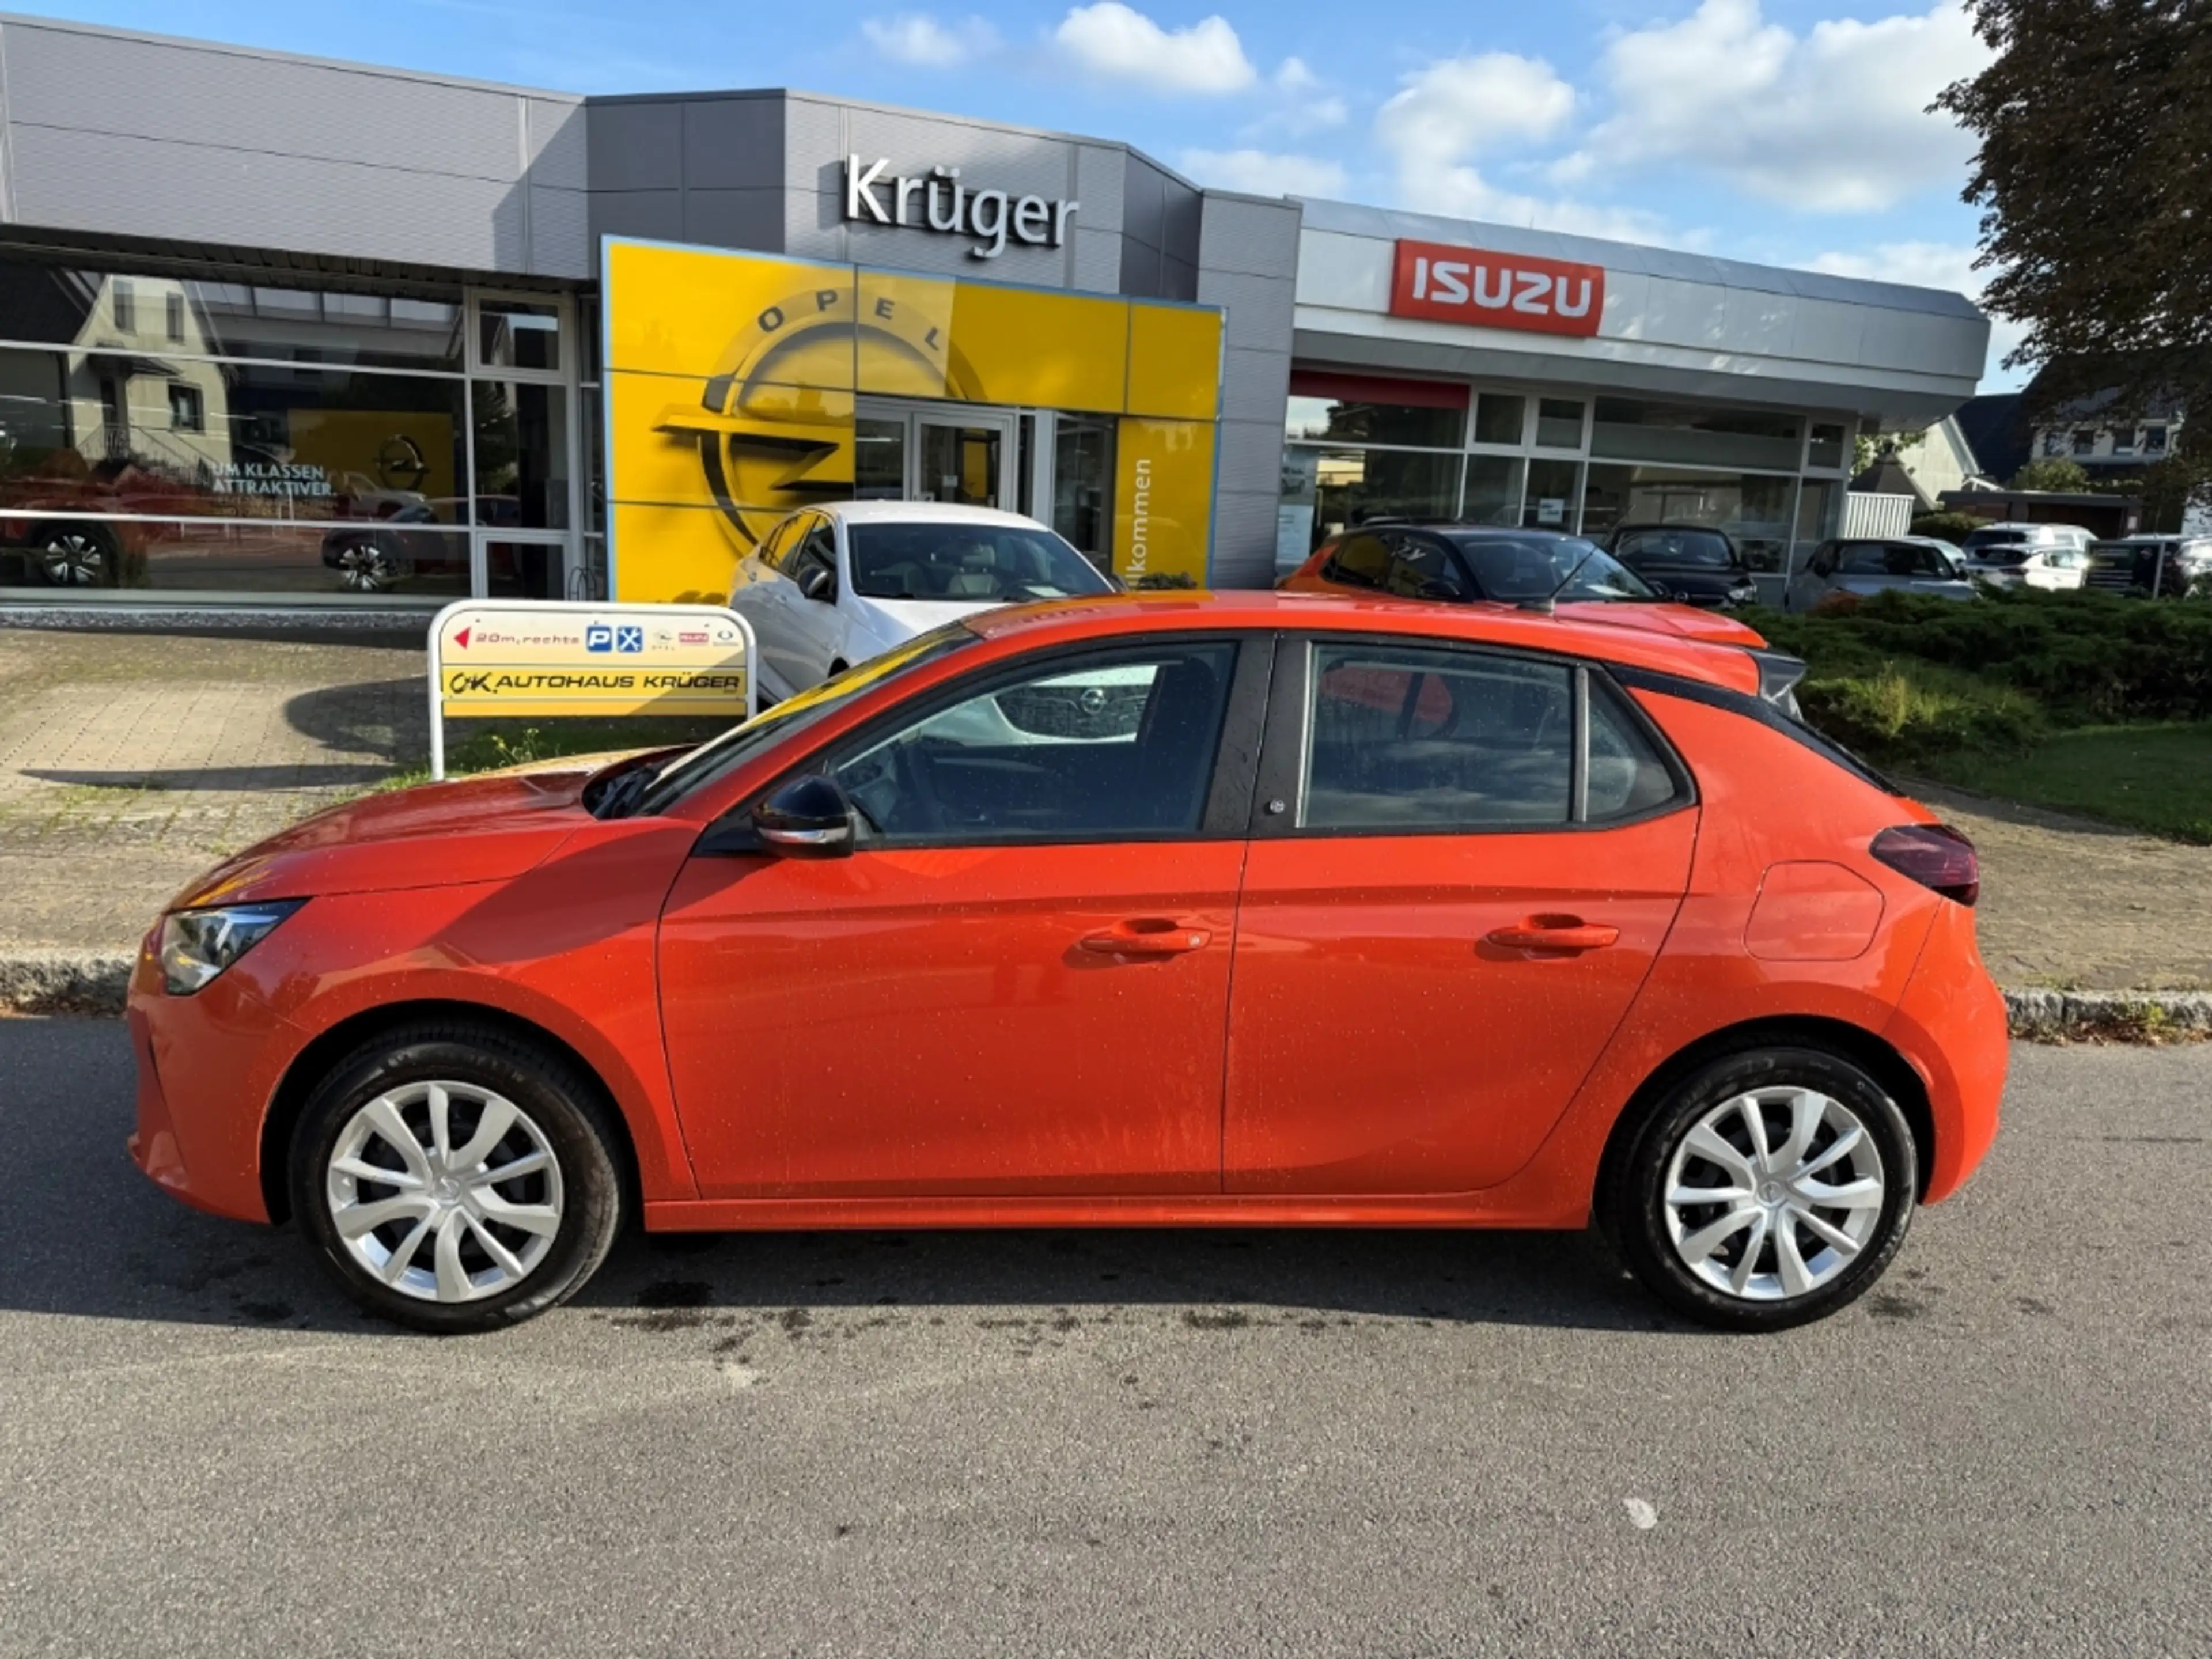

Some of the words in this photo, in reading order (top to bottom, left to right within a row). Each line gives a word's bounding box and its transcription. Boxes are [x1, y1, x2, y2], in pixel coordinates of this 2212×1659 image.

[847, 153, 1081, 259] Krüger
[1412, 257, 1592, 317] ISUZU
[757, 289, 939, 351] OPEL
[211, 462, 241, 476] UM
[244, 462, 324, 480] KLASSEN
[495, 675, 635, 688] AUTOHAUS
[643, 671, 740, 688] KRÜGER
